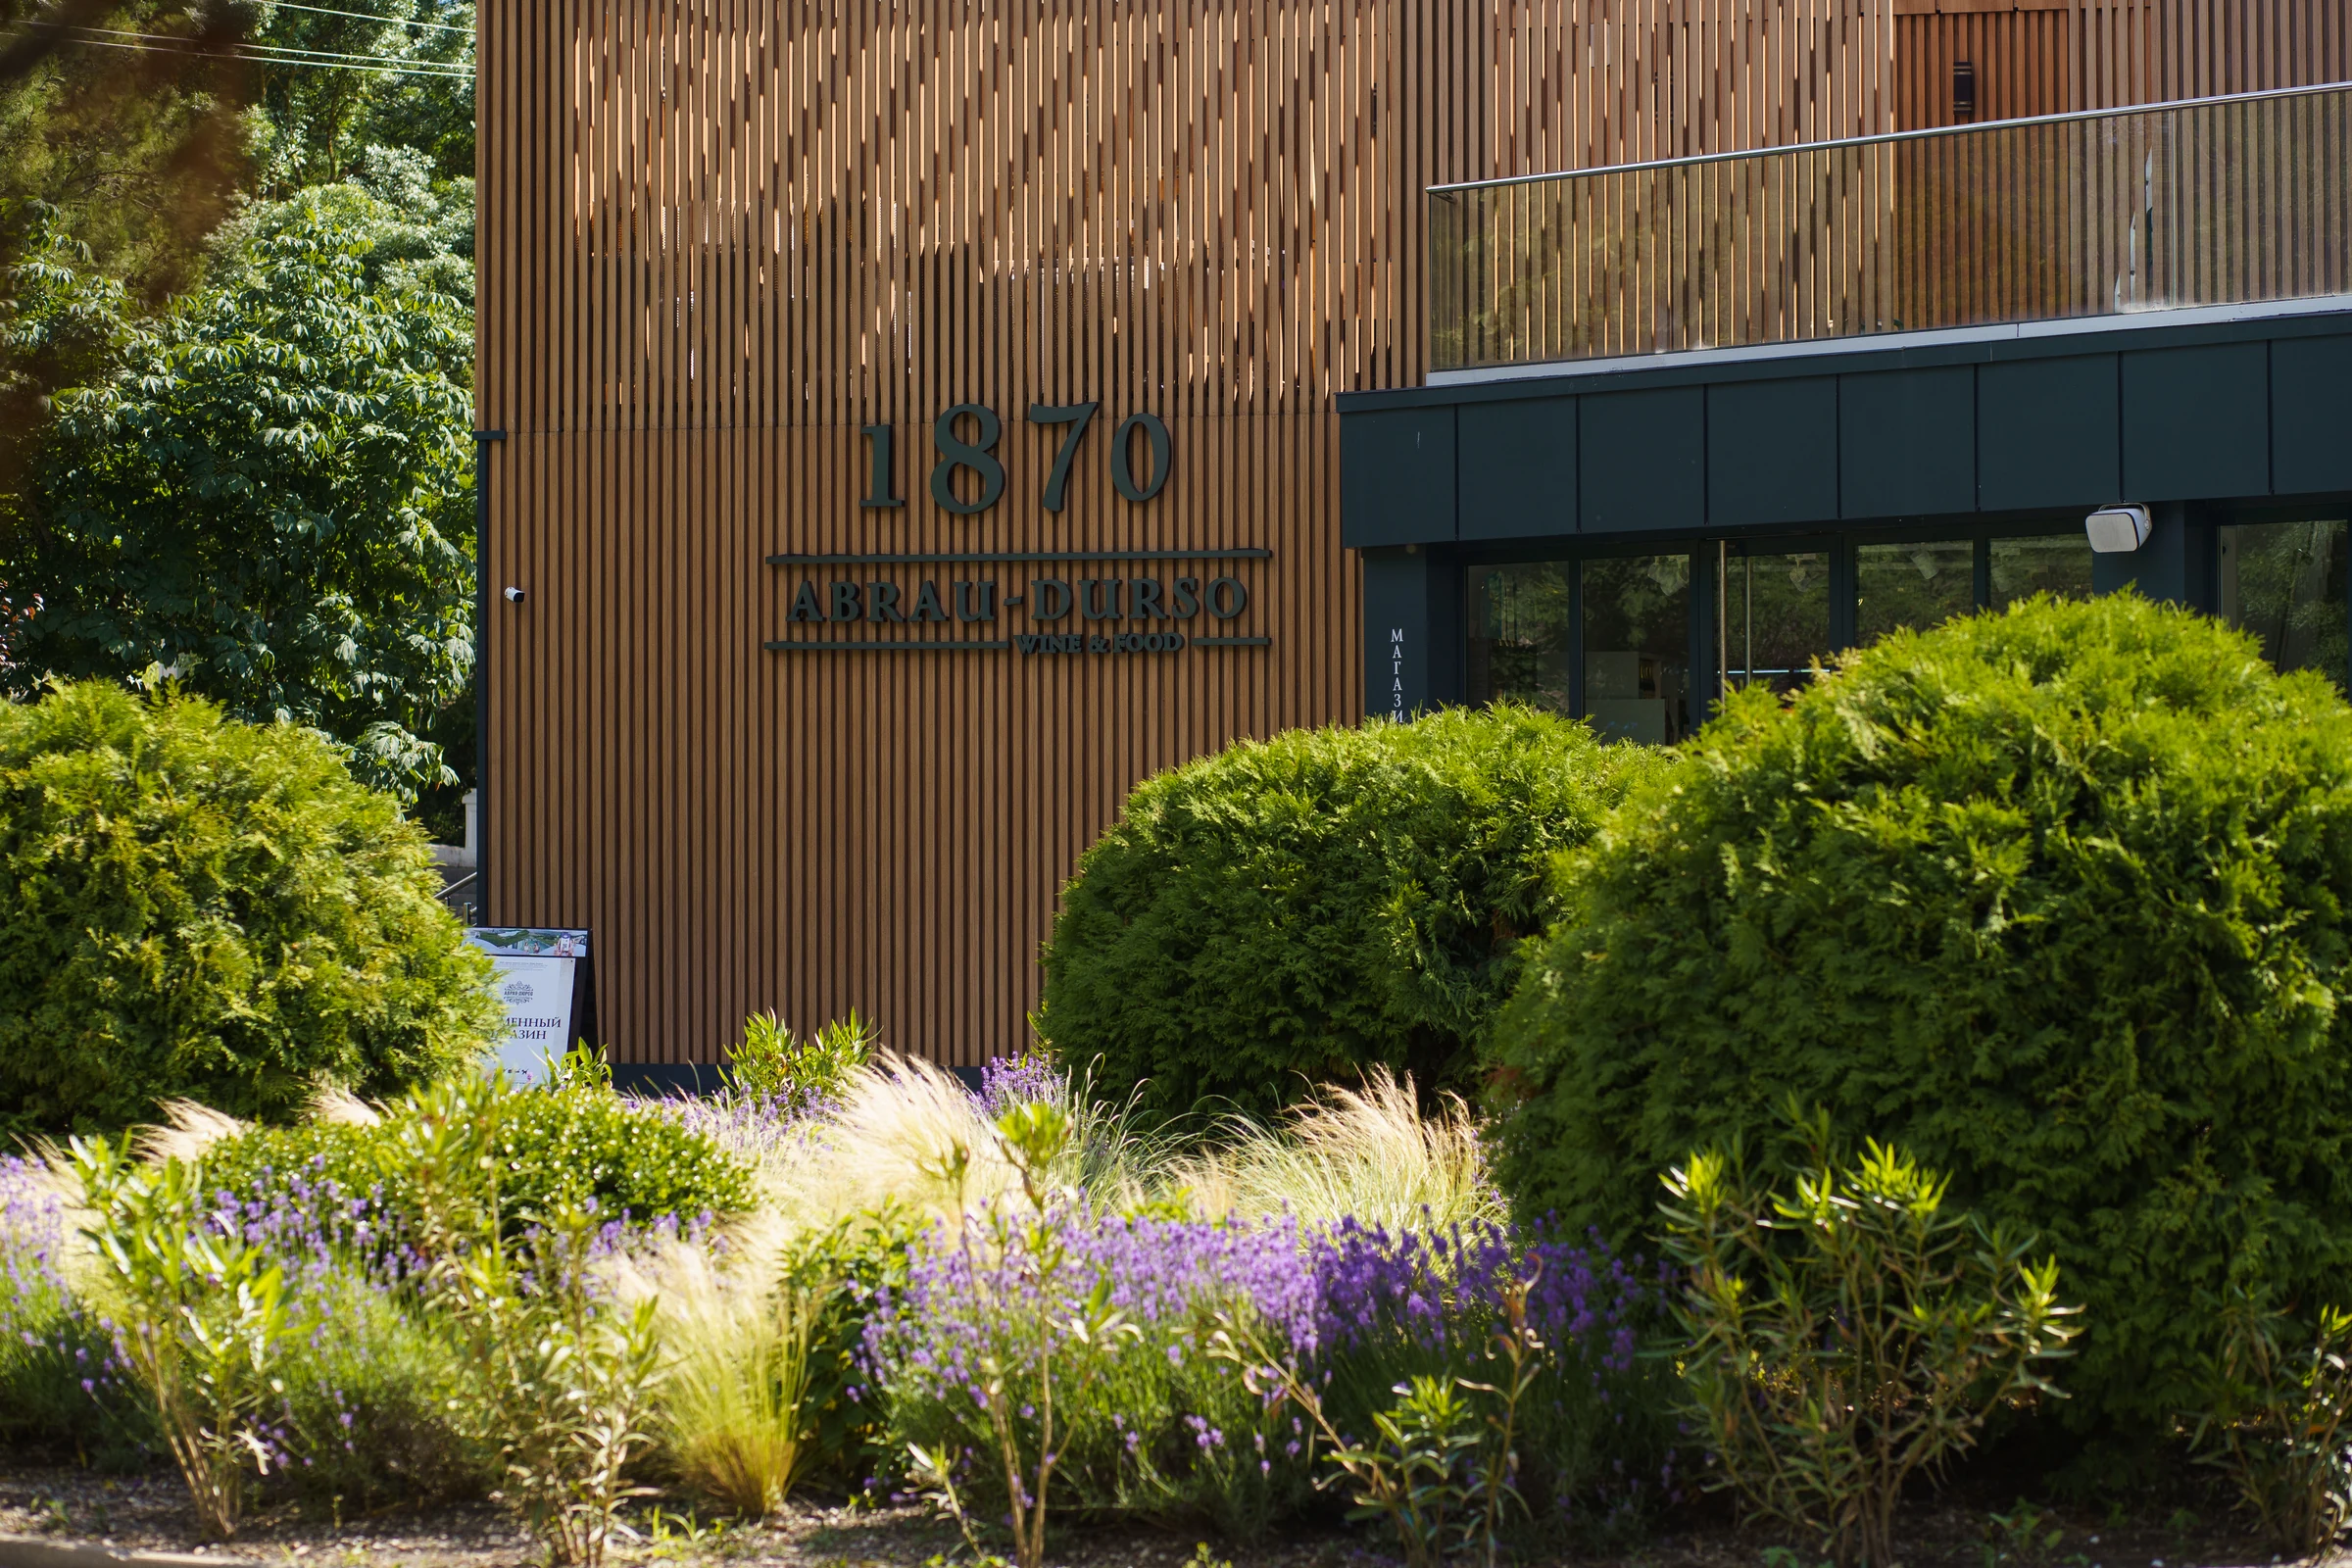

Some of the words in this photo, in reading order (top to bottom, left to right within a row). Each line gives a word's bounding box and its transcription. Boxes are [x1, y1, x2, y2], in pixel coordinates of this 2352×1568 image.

[859, 402, 1172, 514] 1870
[786, 576, 1248, 623] ABRAU-DURSO
[1013, 634, 1083, 655] WINE
[1088, 634, 1110, 654] &
[1112, 632, 1184, 653] FOOD
